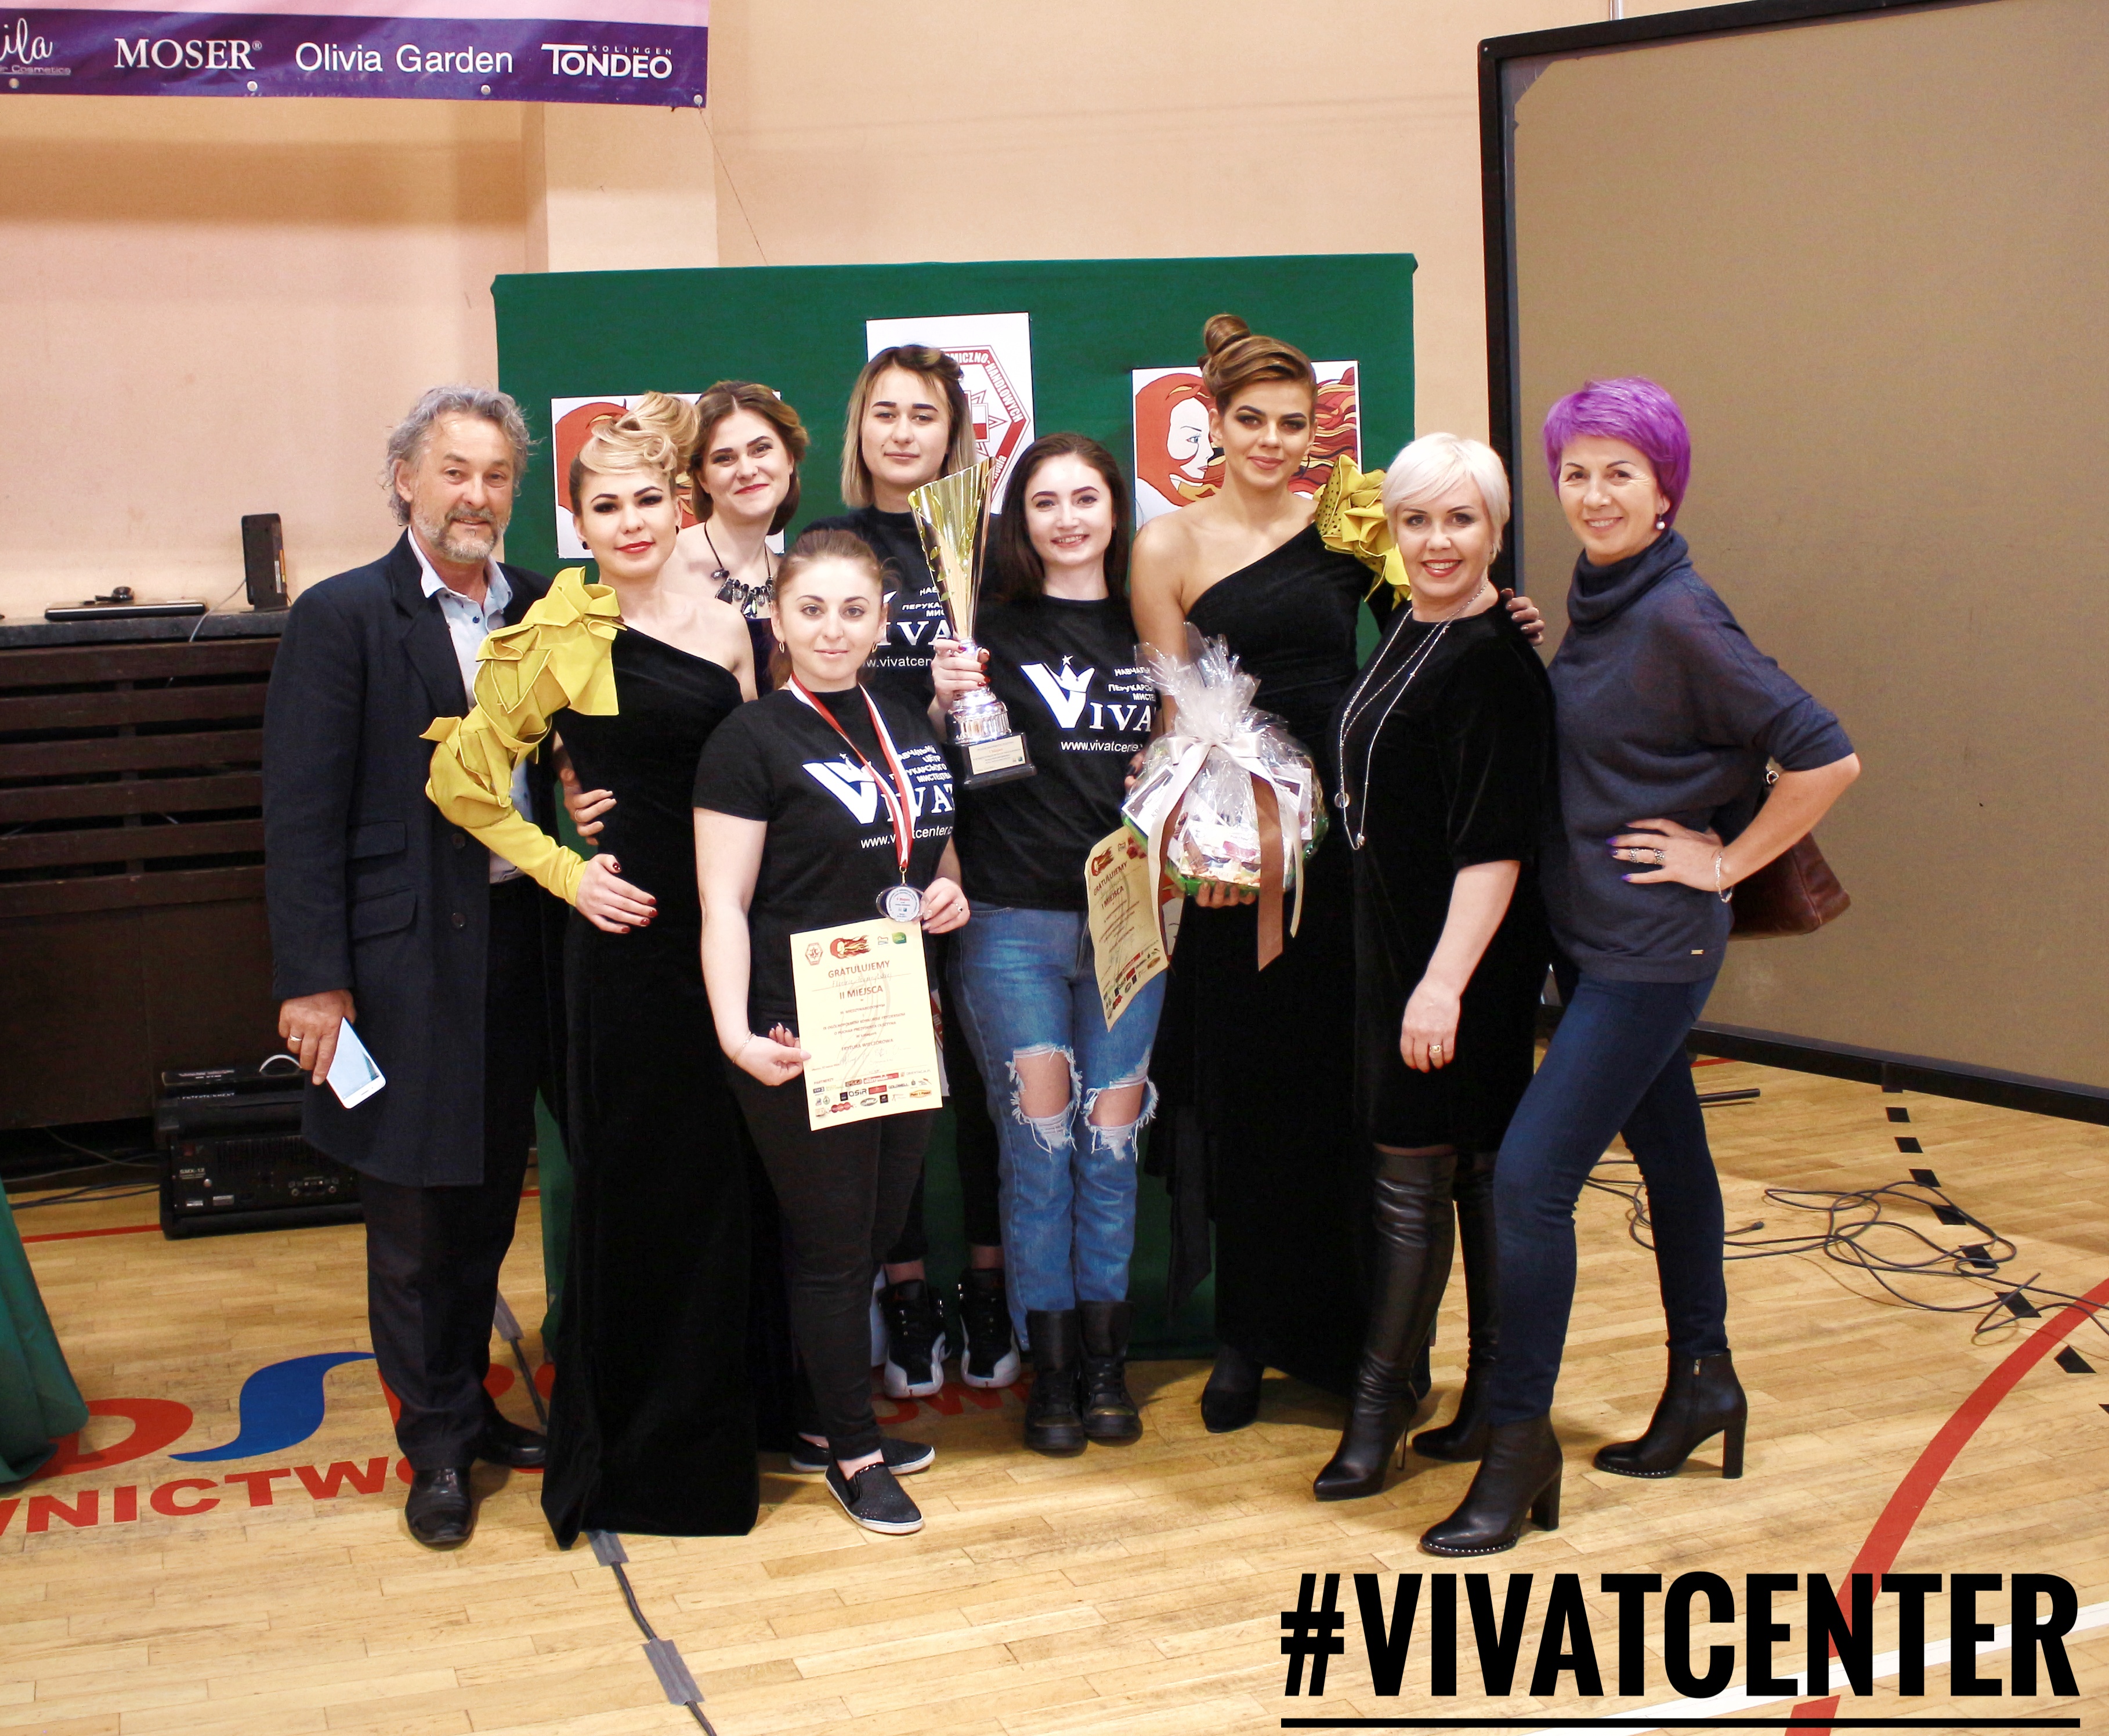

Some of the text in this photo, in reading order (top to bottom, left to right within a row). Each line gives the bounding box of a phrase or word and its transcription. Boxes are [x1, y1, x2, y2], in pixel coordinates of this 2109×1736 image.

[296, 42, 513, 73] Olivia Garden
[541, 44, 672, 79] TONDEO
[592, 45, 672, 55] SOLINGEN
[1021, 663, 1156, 732] VIVA
[828, 960, 890, 978] GRATULUJEMY
[847, 985, 883, 999] MIEJSCA
[0, 1456, 414, 1537] NICTW
